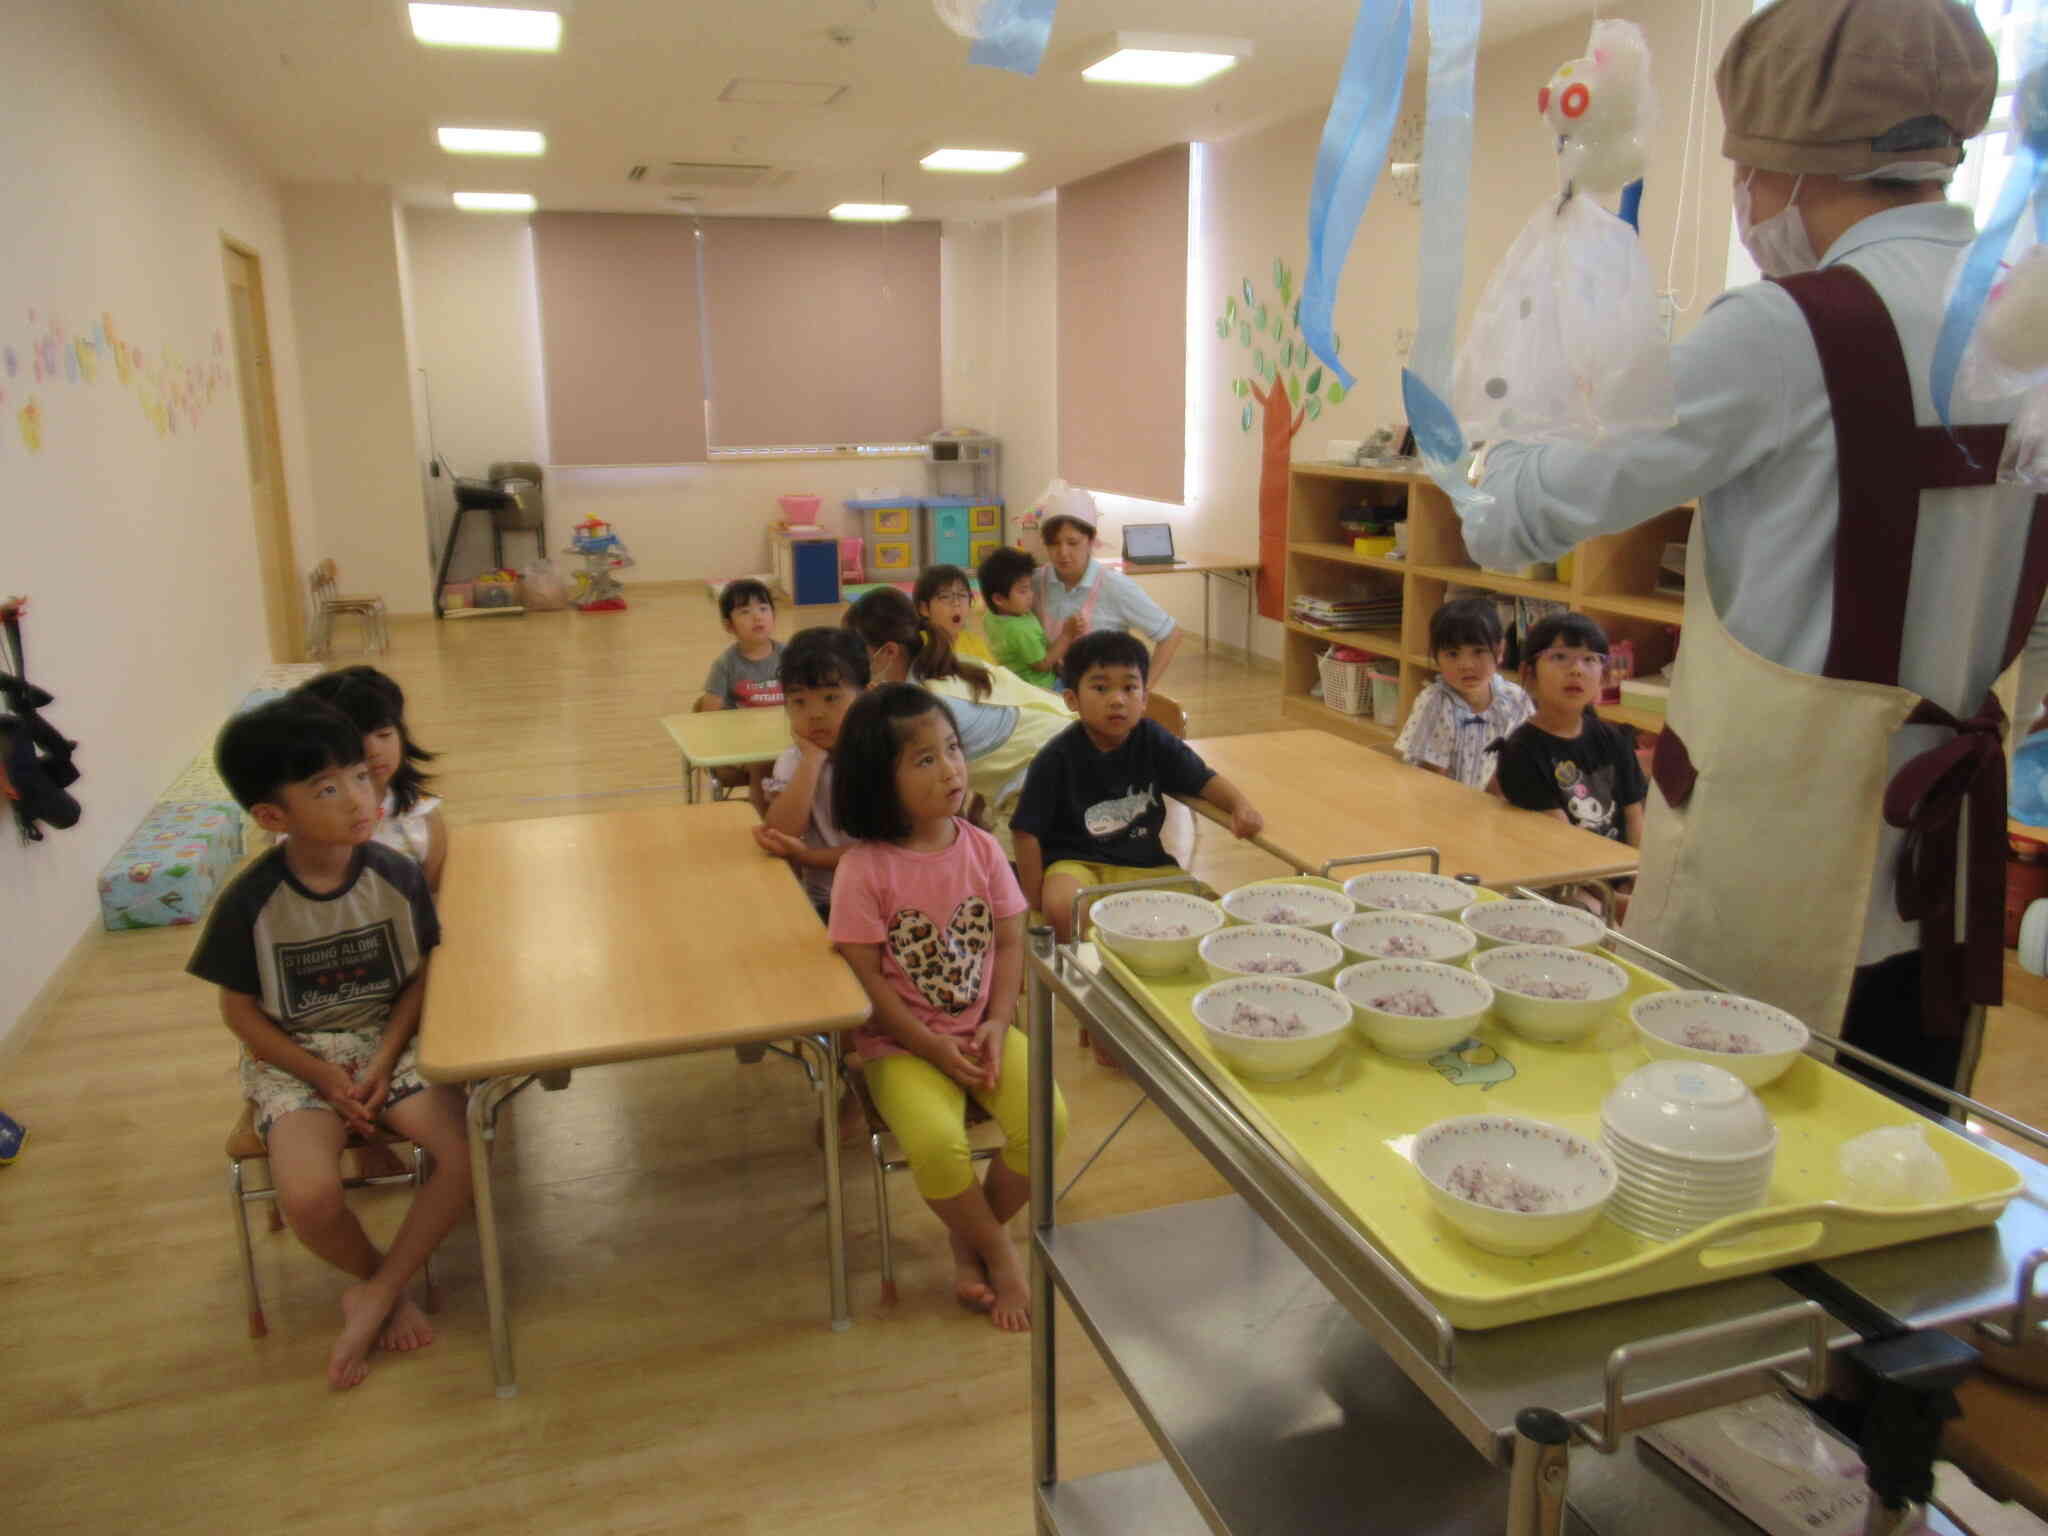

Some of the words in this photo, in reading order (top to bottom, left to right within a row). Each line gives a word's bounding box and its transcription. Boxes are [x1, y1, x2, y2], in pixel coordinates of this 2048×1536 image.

[287, 944, 338, 967] STRONG
[341, 935, 383, 955] ALONE
[298, 990, 339, 1009] Stay
